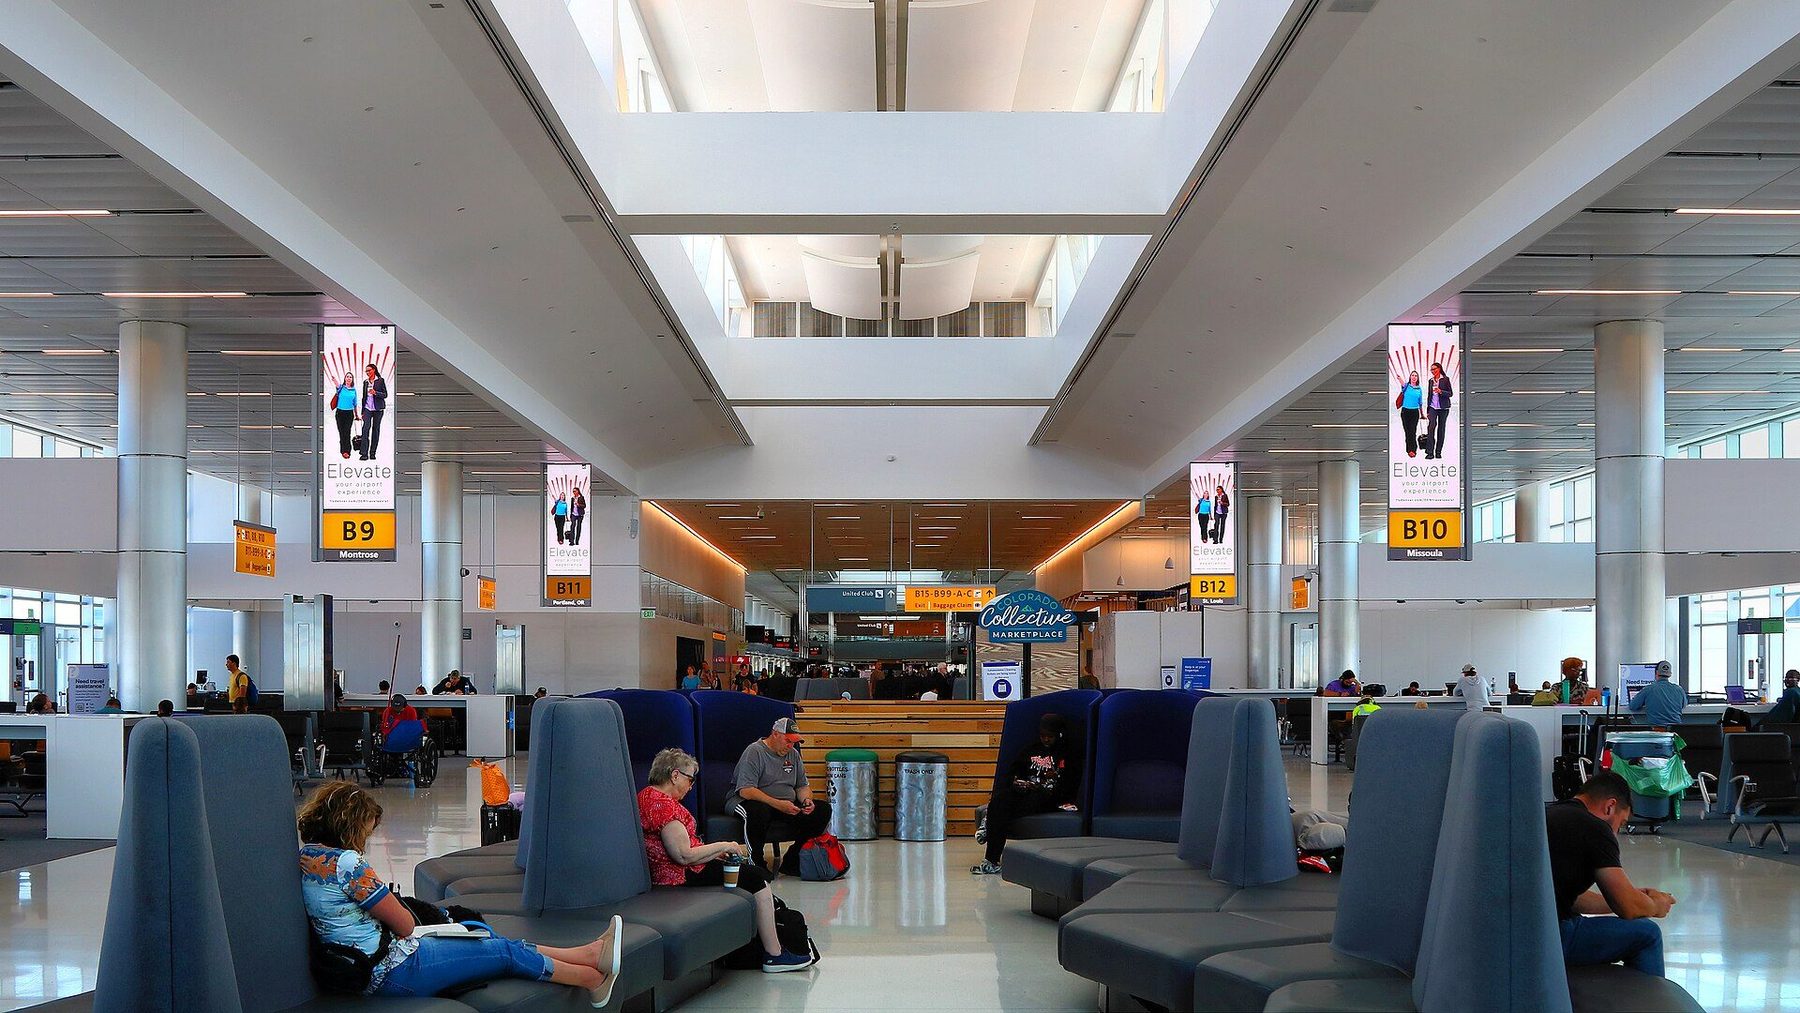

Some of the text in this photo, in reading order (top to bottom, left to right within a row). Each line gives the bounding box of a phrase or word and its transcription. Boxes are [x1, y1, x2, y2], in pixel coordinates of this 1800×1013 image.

[328, 463, 391, 478] Elevate
[1394, 462, 1456, 478] Elevate
[342, 520, 374, 541] B9
[1404, 519, 1448, 540] B10
[550, 548, 588, 556] Elevate
[1193, 546, 1232, 556] Elevate
[1407, 549, 1443, 557] Missoula
[558, 582, 580, 594] B11
[1200, 580, 1226, 593] B12
[997, 593, 1058, 610] COLORADO
[981, 605, 1074, 627] Collective
